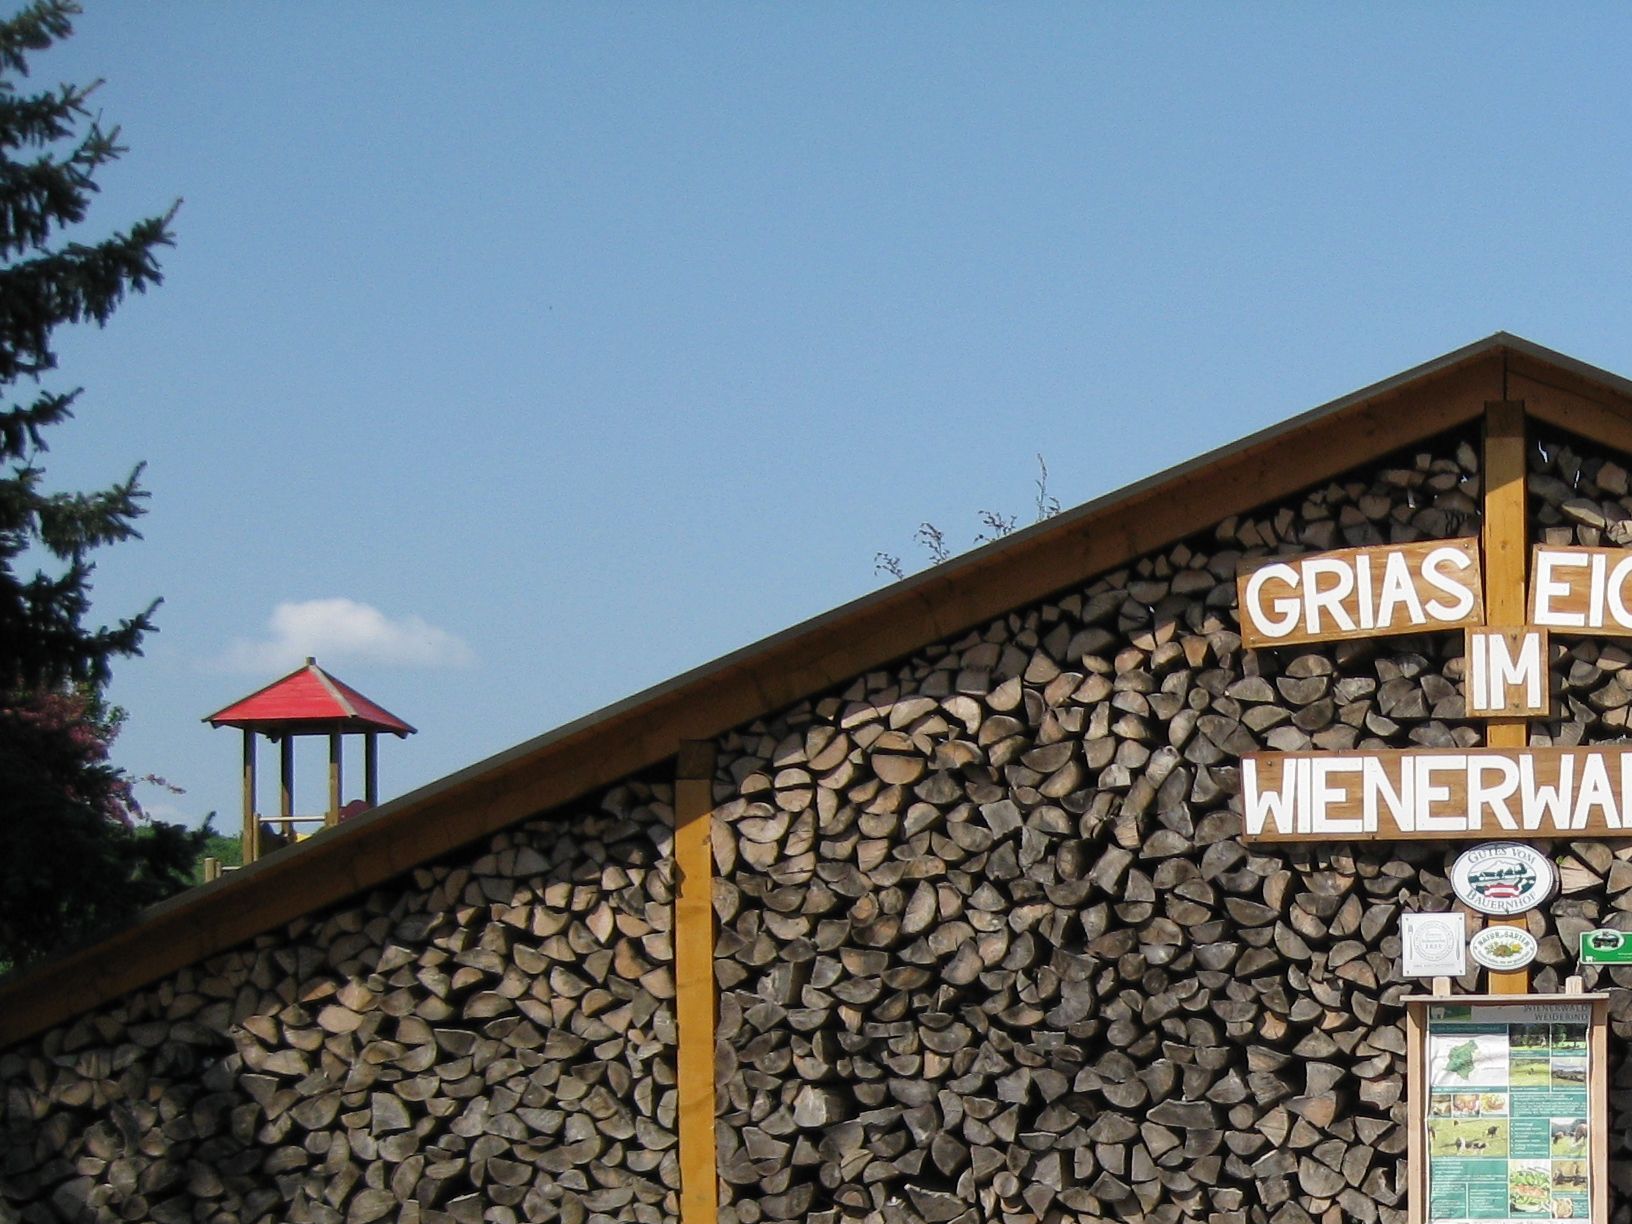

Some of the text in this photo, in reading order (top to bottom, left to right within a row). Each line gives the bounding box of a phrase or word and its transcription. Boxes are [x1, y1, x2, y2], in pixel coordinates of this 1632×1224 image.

[1246, 547, 1474, 637] GRIAS
[1472, 632, 1541, 710] IM
[1467, 848, 1536, 864] GUTES VOM
[1466, 889, 1537, 909] BAUERNHOF
